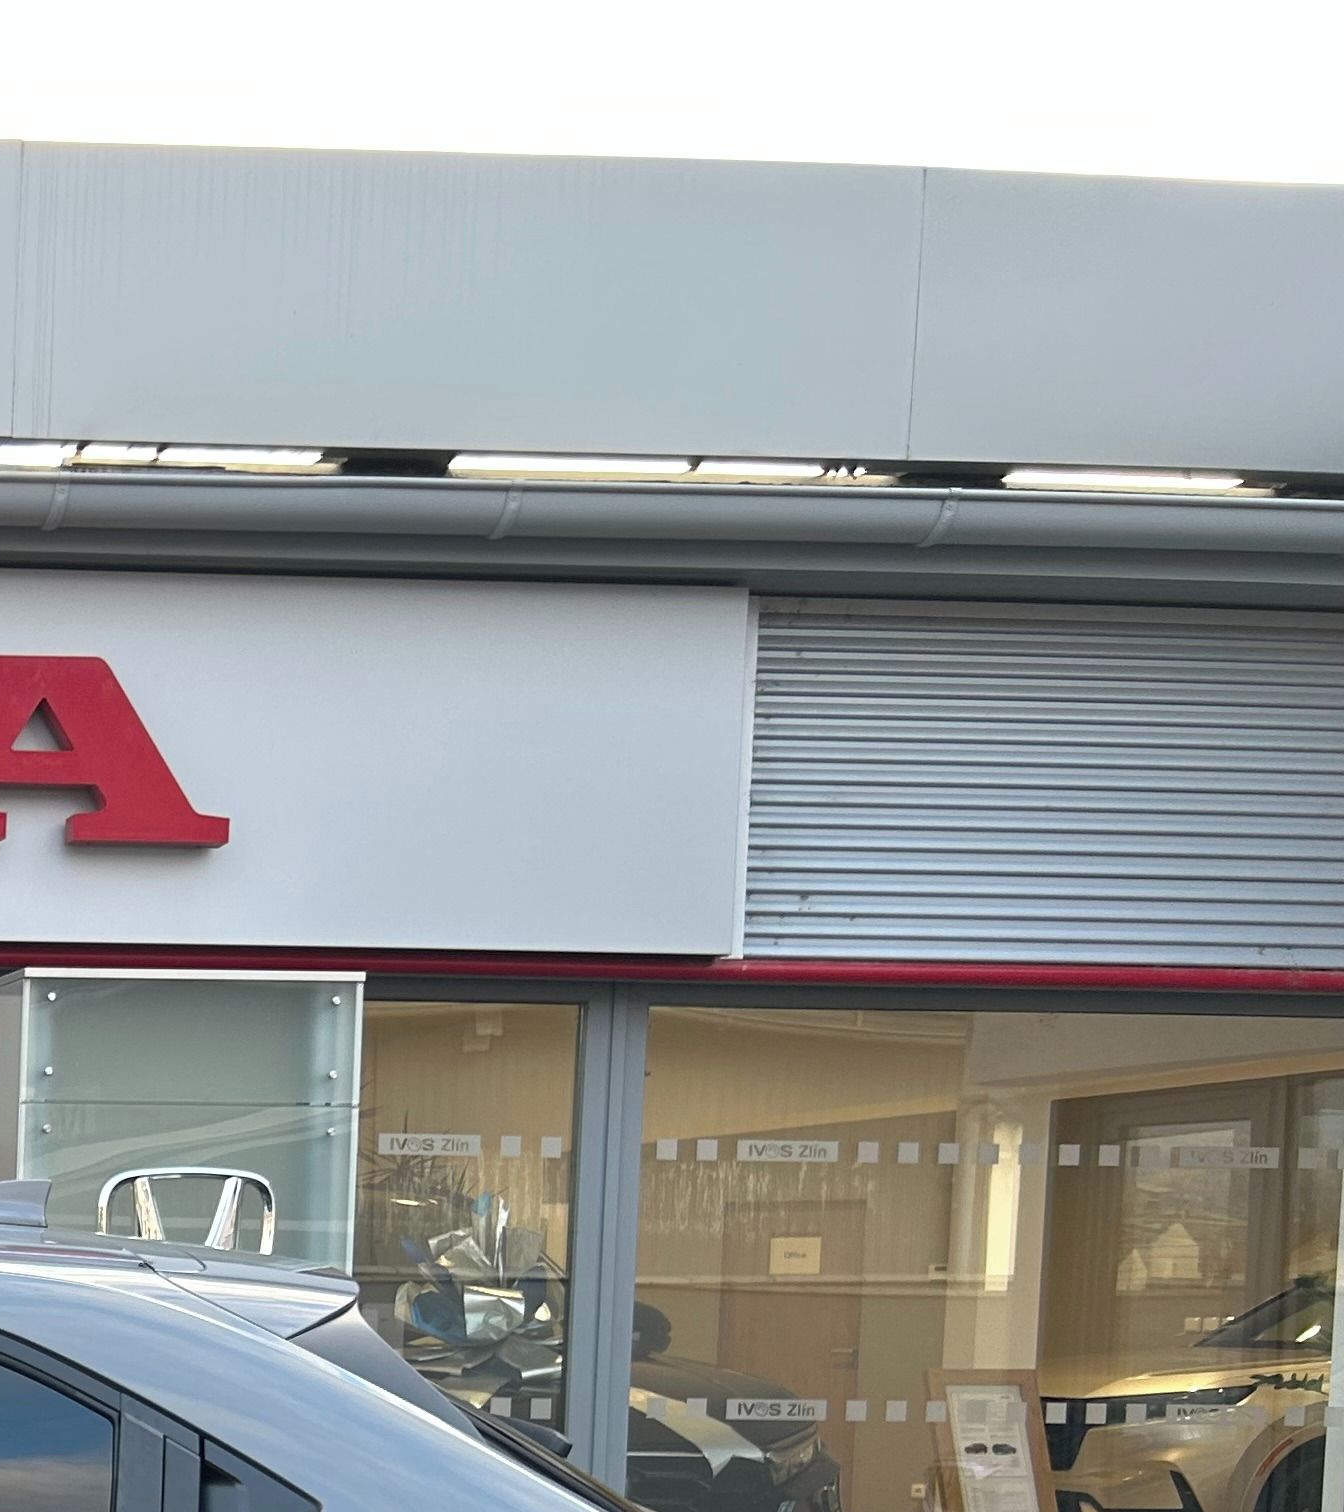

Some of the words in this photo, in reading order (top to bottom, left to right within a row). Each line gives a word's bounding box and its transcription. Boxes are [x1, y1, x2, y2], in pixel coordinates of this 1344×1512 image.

[390, 1137, 435, 1152] IVOS
[441, 1138, 469, 1152] Zlín
[748, 1144, 793, 1158] IVOS
[799, 1144, 827, 1158] Zlín
[737, 1402, 781, 1417] IVOS
[787, 1403, 815, 1417] Zlín
